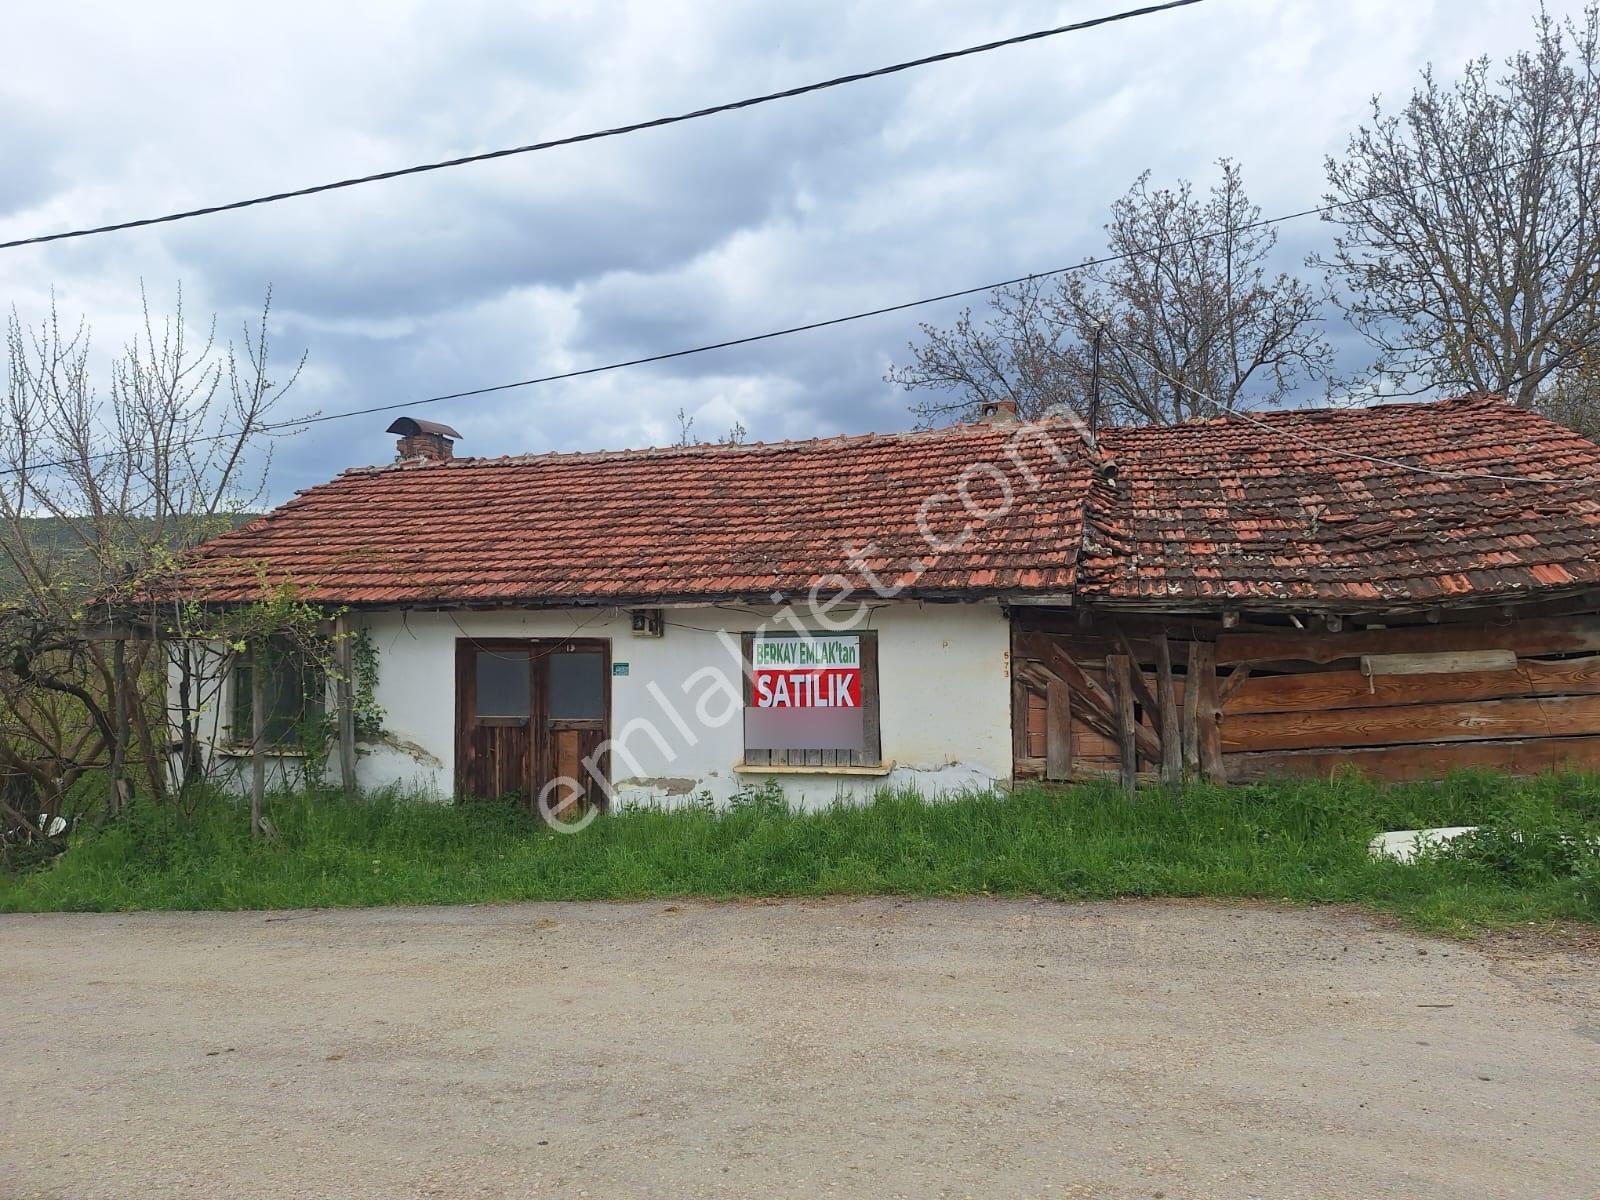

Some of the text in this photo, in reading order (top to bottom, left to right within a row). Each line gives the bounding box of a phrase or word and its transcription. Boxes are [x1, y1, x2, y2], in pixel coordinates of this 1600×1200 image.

[756, 641, 855, 664] BERKAY EMLAK'tan
[757, 673, 854, 707] SATILIK
